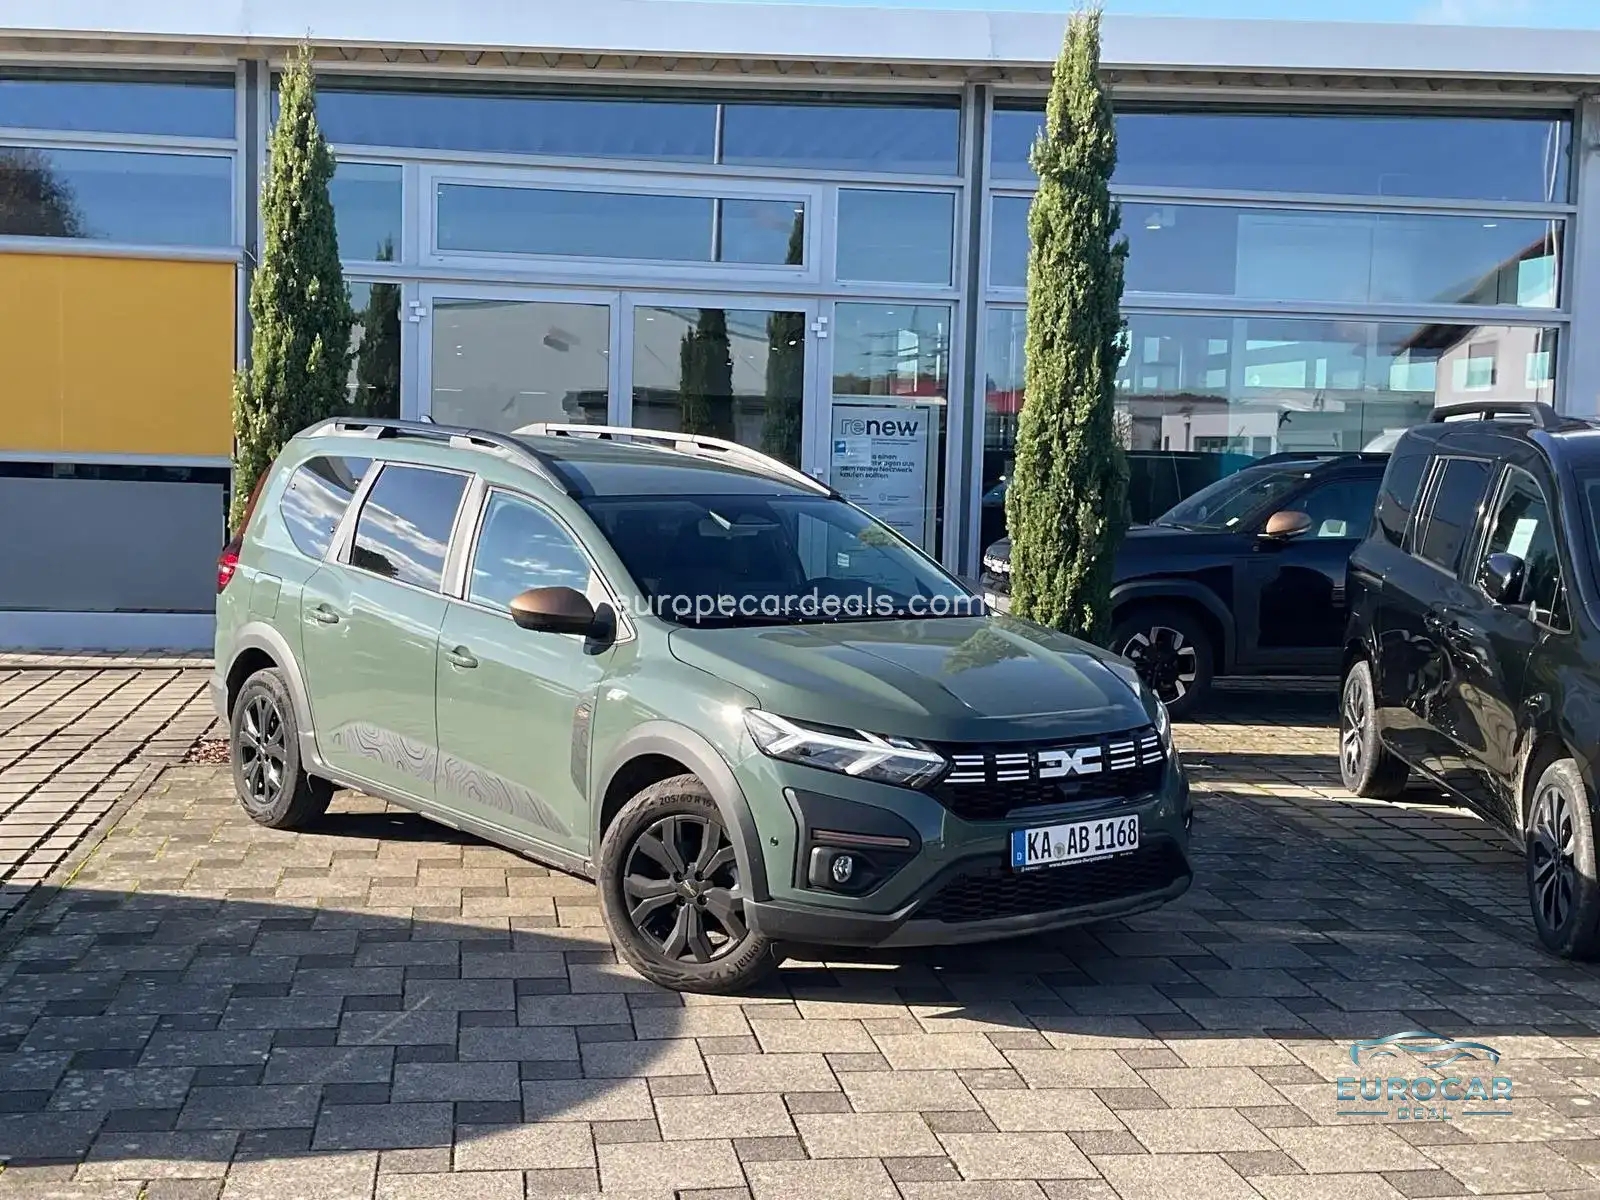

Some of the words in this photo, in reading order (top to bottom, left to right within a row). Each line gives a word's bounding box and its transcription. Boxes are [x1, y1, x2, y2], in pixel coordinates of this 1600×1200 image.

[840, 418, 918, 436] renew
[1016, 852, 1022, 861] D
[1027, 831, 1051, 861] KA
[1067, 826, 1090, 855] AB
[1095, 818, 1137, 851] 1168
